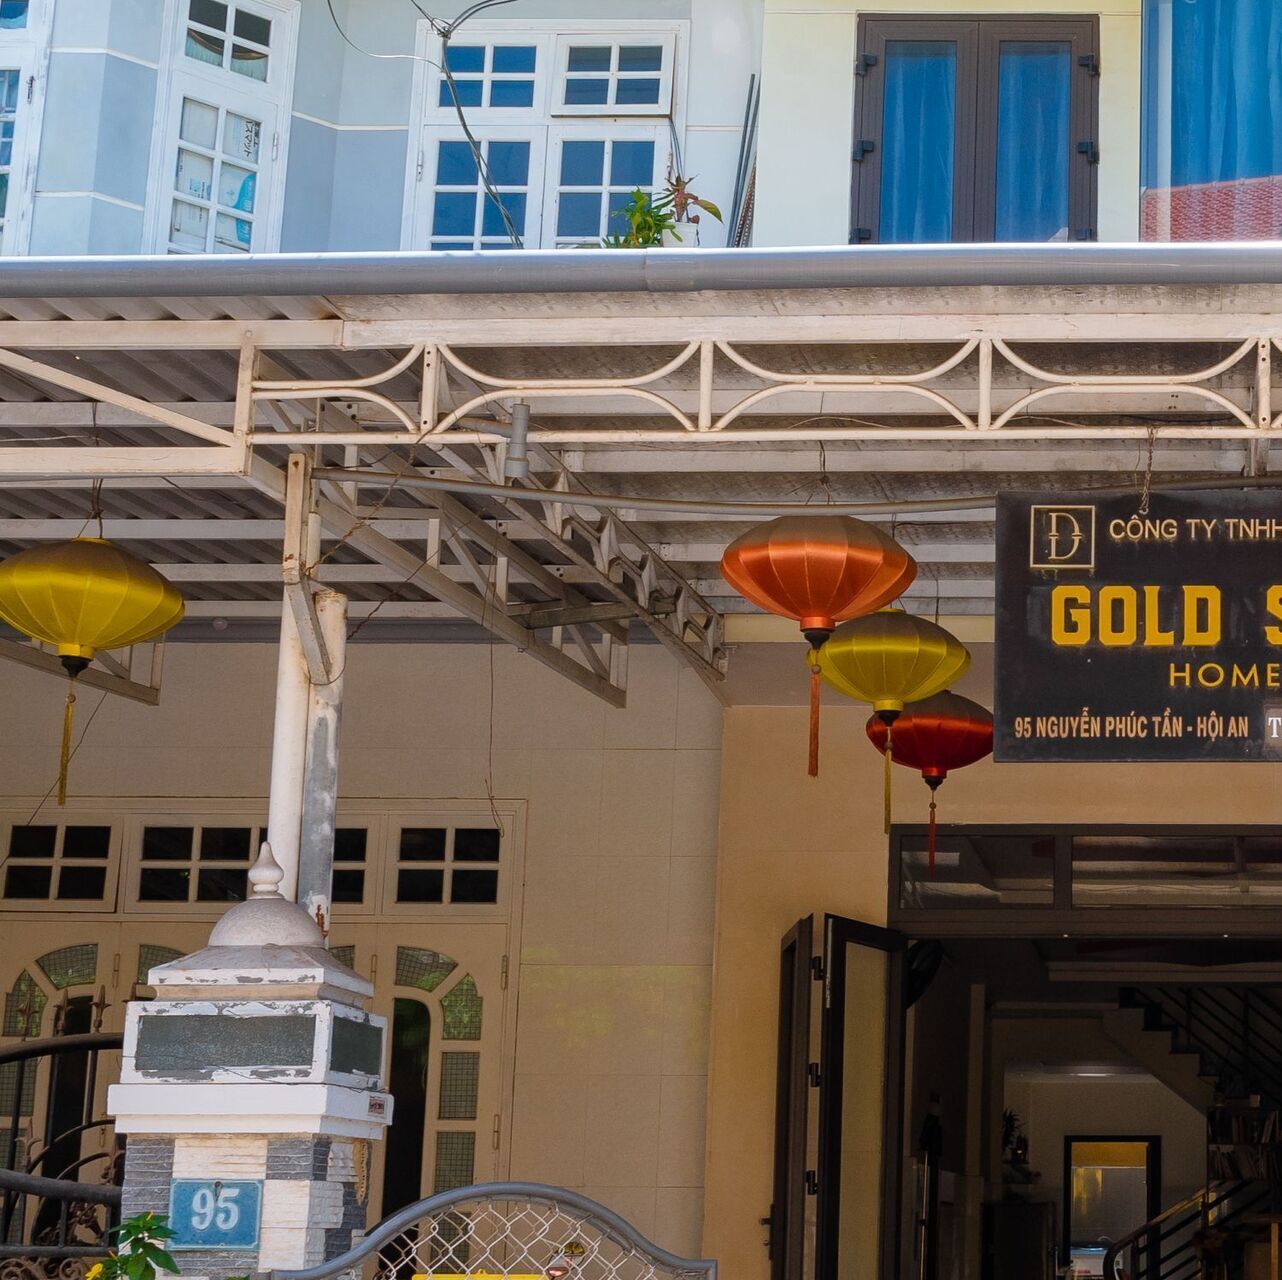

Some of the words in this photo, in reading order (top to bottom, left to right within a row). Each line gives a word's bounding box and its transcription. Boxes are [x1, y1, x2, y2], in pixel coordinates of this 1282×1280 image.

[1109, 514, 1178, 540] CÔNG
[1186, 519, 1216, 539] TY
[1051, 585, 1221, 646] GOLD
[1015, 717, 1032, 738] 95
[1036, 706, 1100, 738] NGUYỄN
[1105, 710, 1147, 738] PHÚC
[1197, 710, 1223, 742] HỘI
[1228, 716, 1248, 737] AN
[191, 1187, 240, 1231] 95
